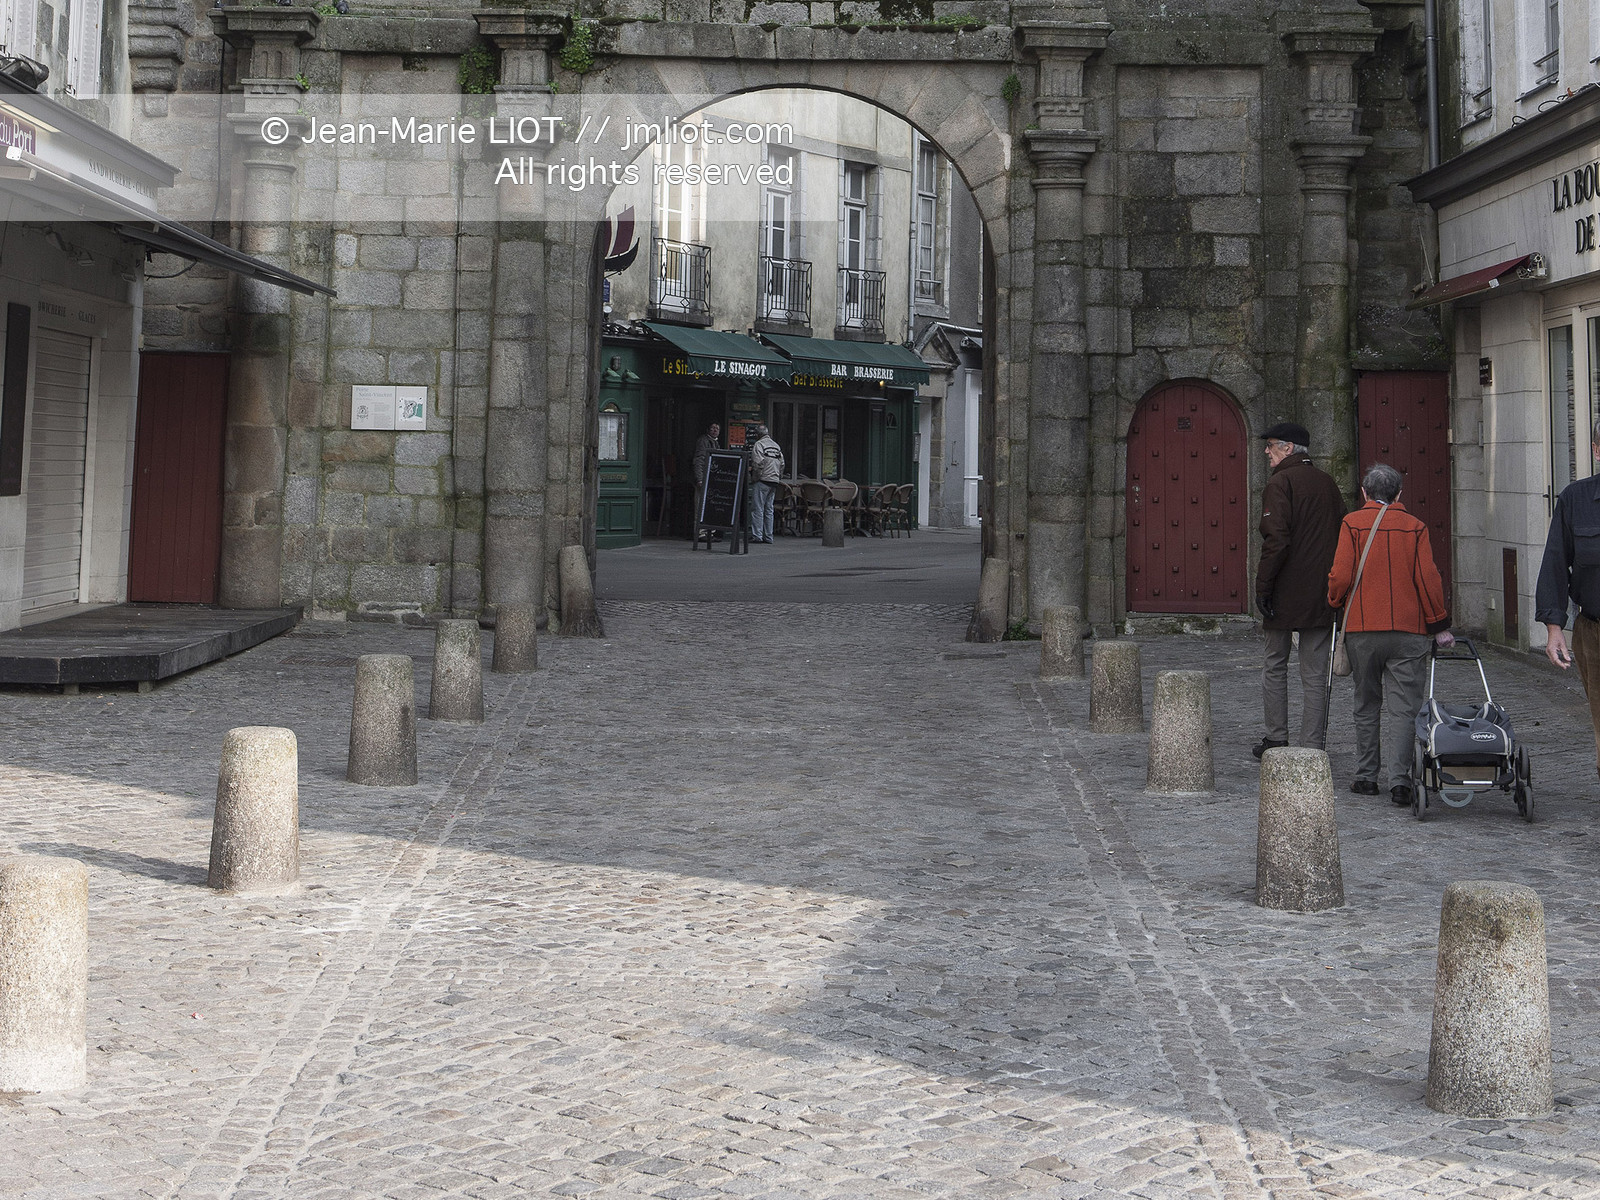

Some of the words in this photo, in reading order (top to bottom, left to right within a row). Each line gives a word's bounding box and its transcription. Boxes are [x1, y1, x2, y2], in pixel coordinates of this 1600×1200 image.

[0, 115, 12, 146] du
[12, 118, 33, 154] Port
[1553, 174, 1572, 213] LA
[1575, 214, 1596, 254] DE
[663, 358, 673, 374] Le
[714, 360, 726, 373] LE
[728, 361, 767, 377] SINAGOT
[831, 363, 848, 377] BAR
[854, 366, 894, 380] BRASSERIE
